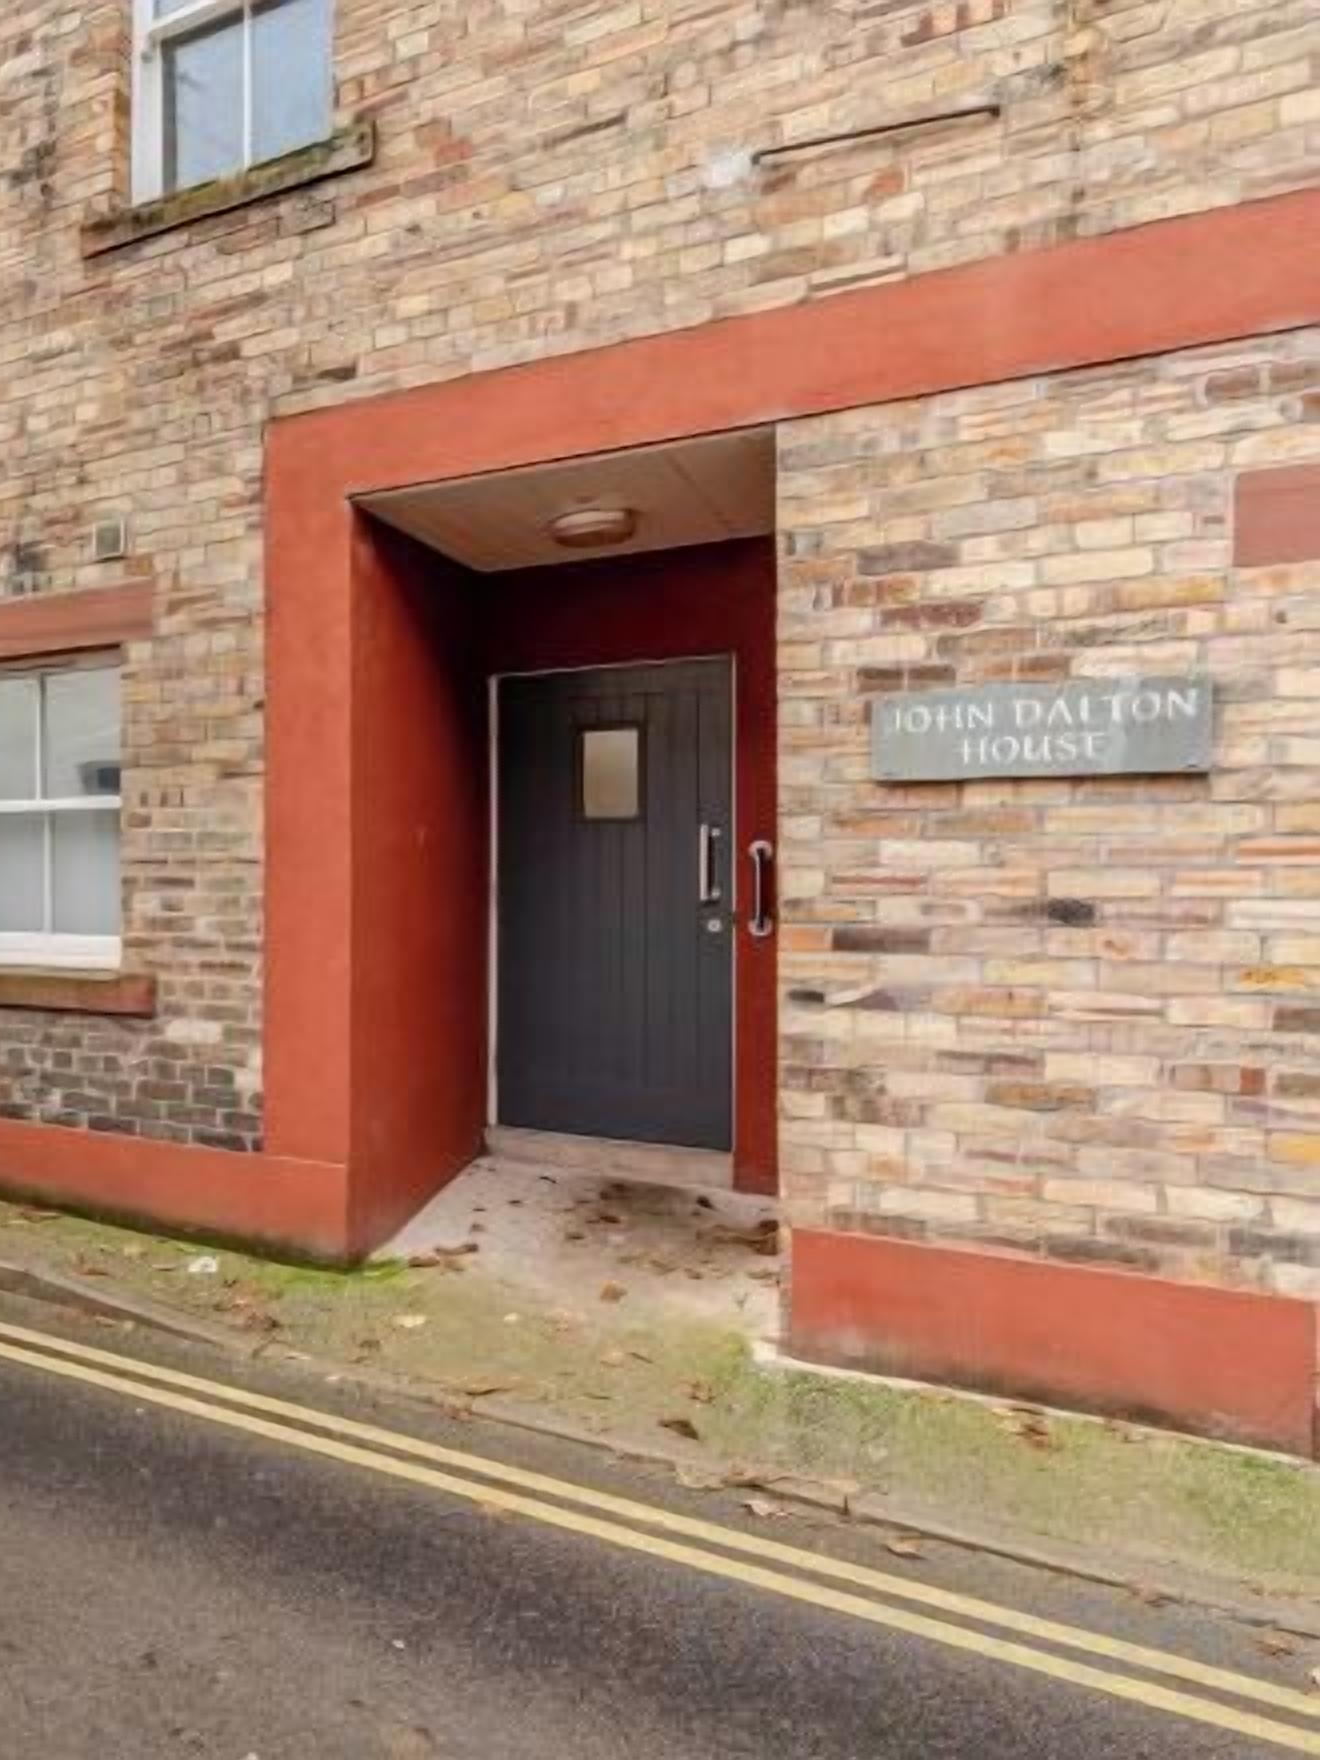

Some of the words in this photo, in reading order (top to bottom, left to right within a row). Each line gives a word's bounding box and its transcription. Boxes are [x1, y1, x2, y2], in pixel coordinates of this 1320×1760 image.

[891, 702, 994, 733] JOHN
[1014, 688, 1198, 728] DALTON
[961, 732, 1106, 765] HOUSE
